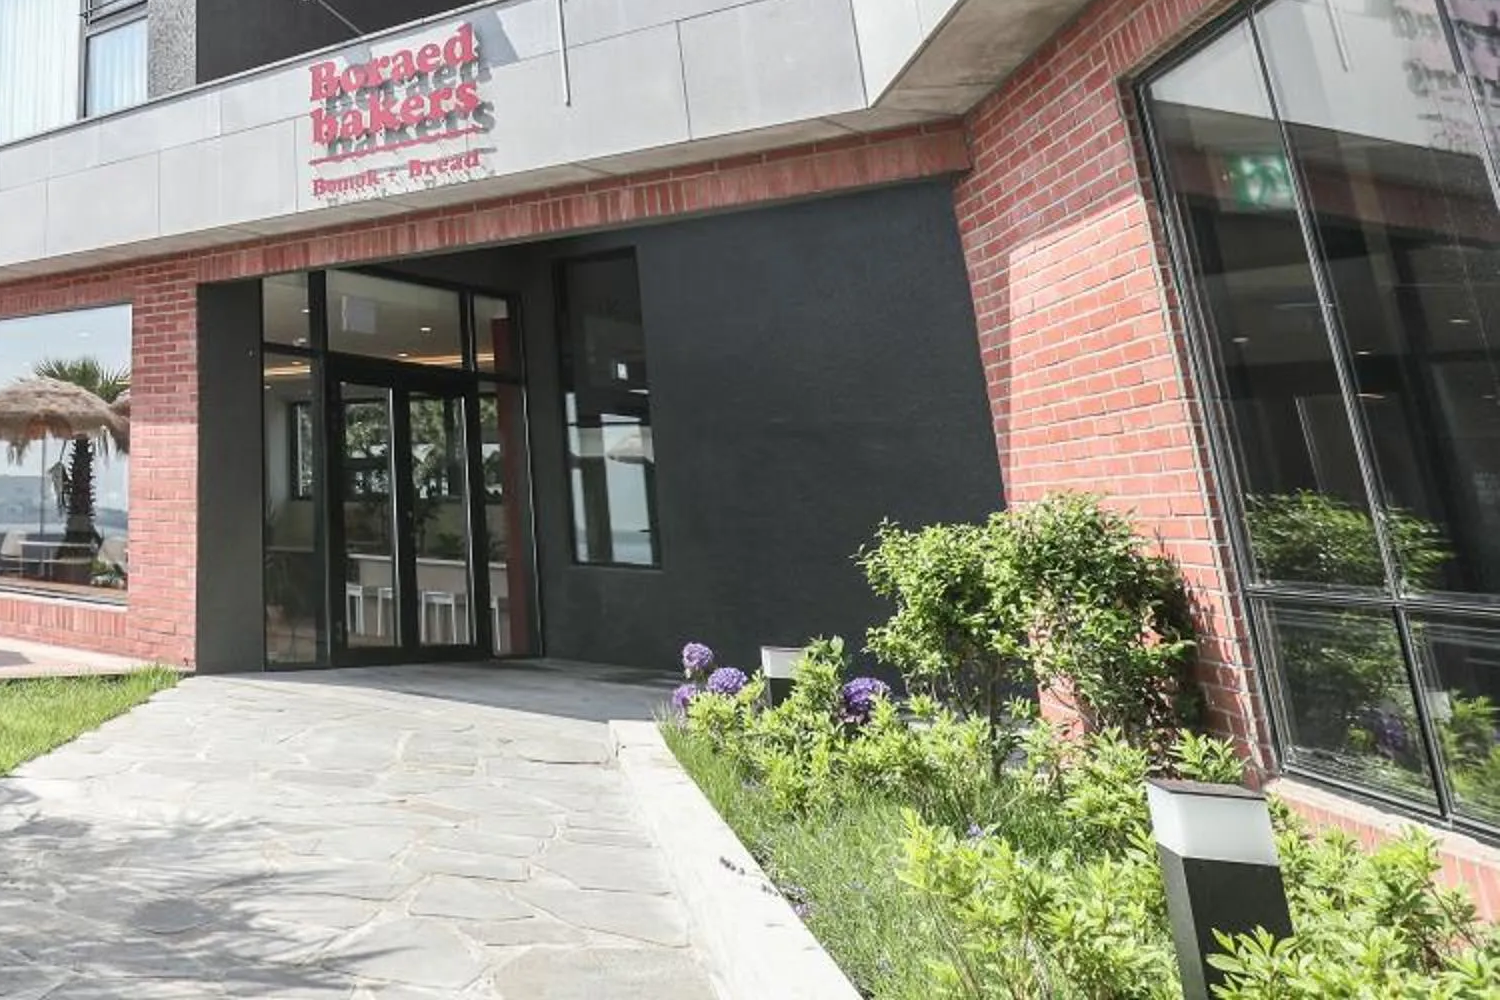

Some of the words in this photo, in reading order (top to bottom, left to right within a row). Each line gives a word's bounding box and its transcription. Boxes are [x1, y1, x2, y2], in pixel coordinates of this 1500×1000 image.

[309, 23, 478, 100] Boraed
[310, 83, 479, 145] bakers
[408, 150, 481, 177] Bread
